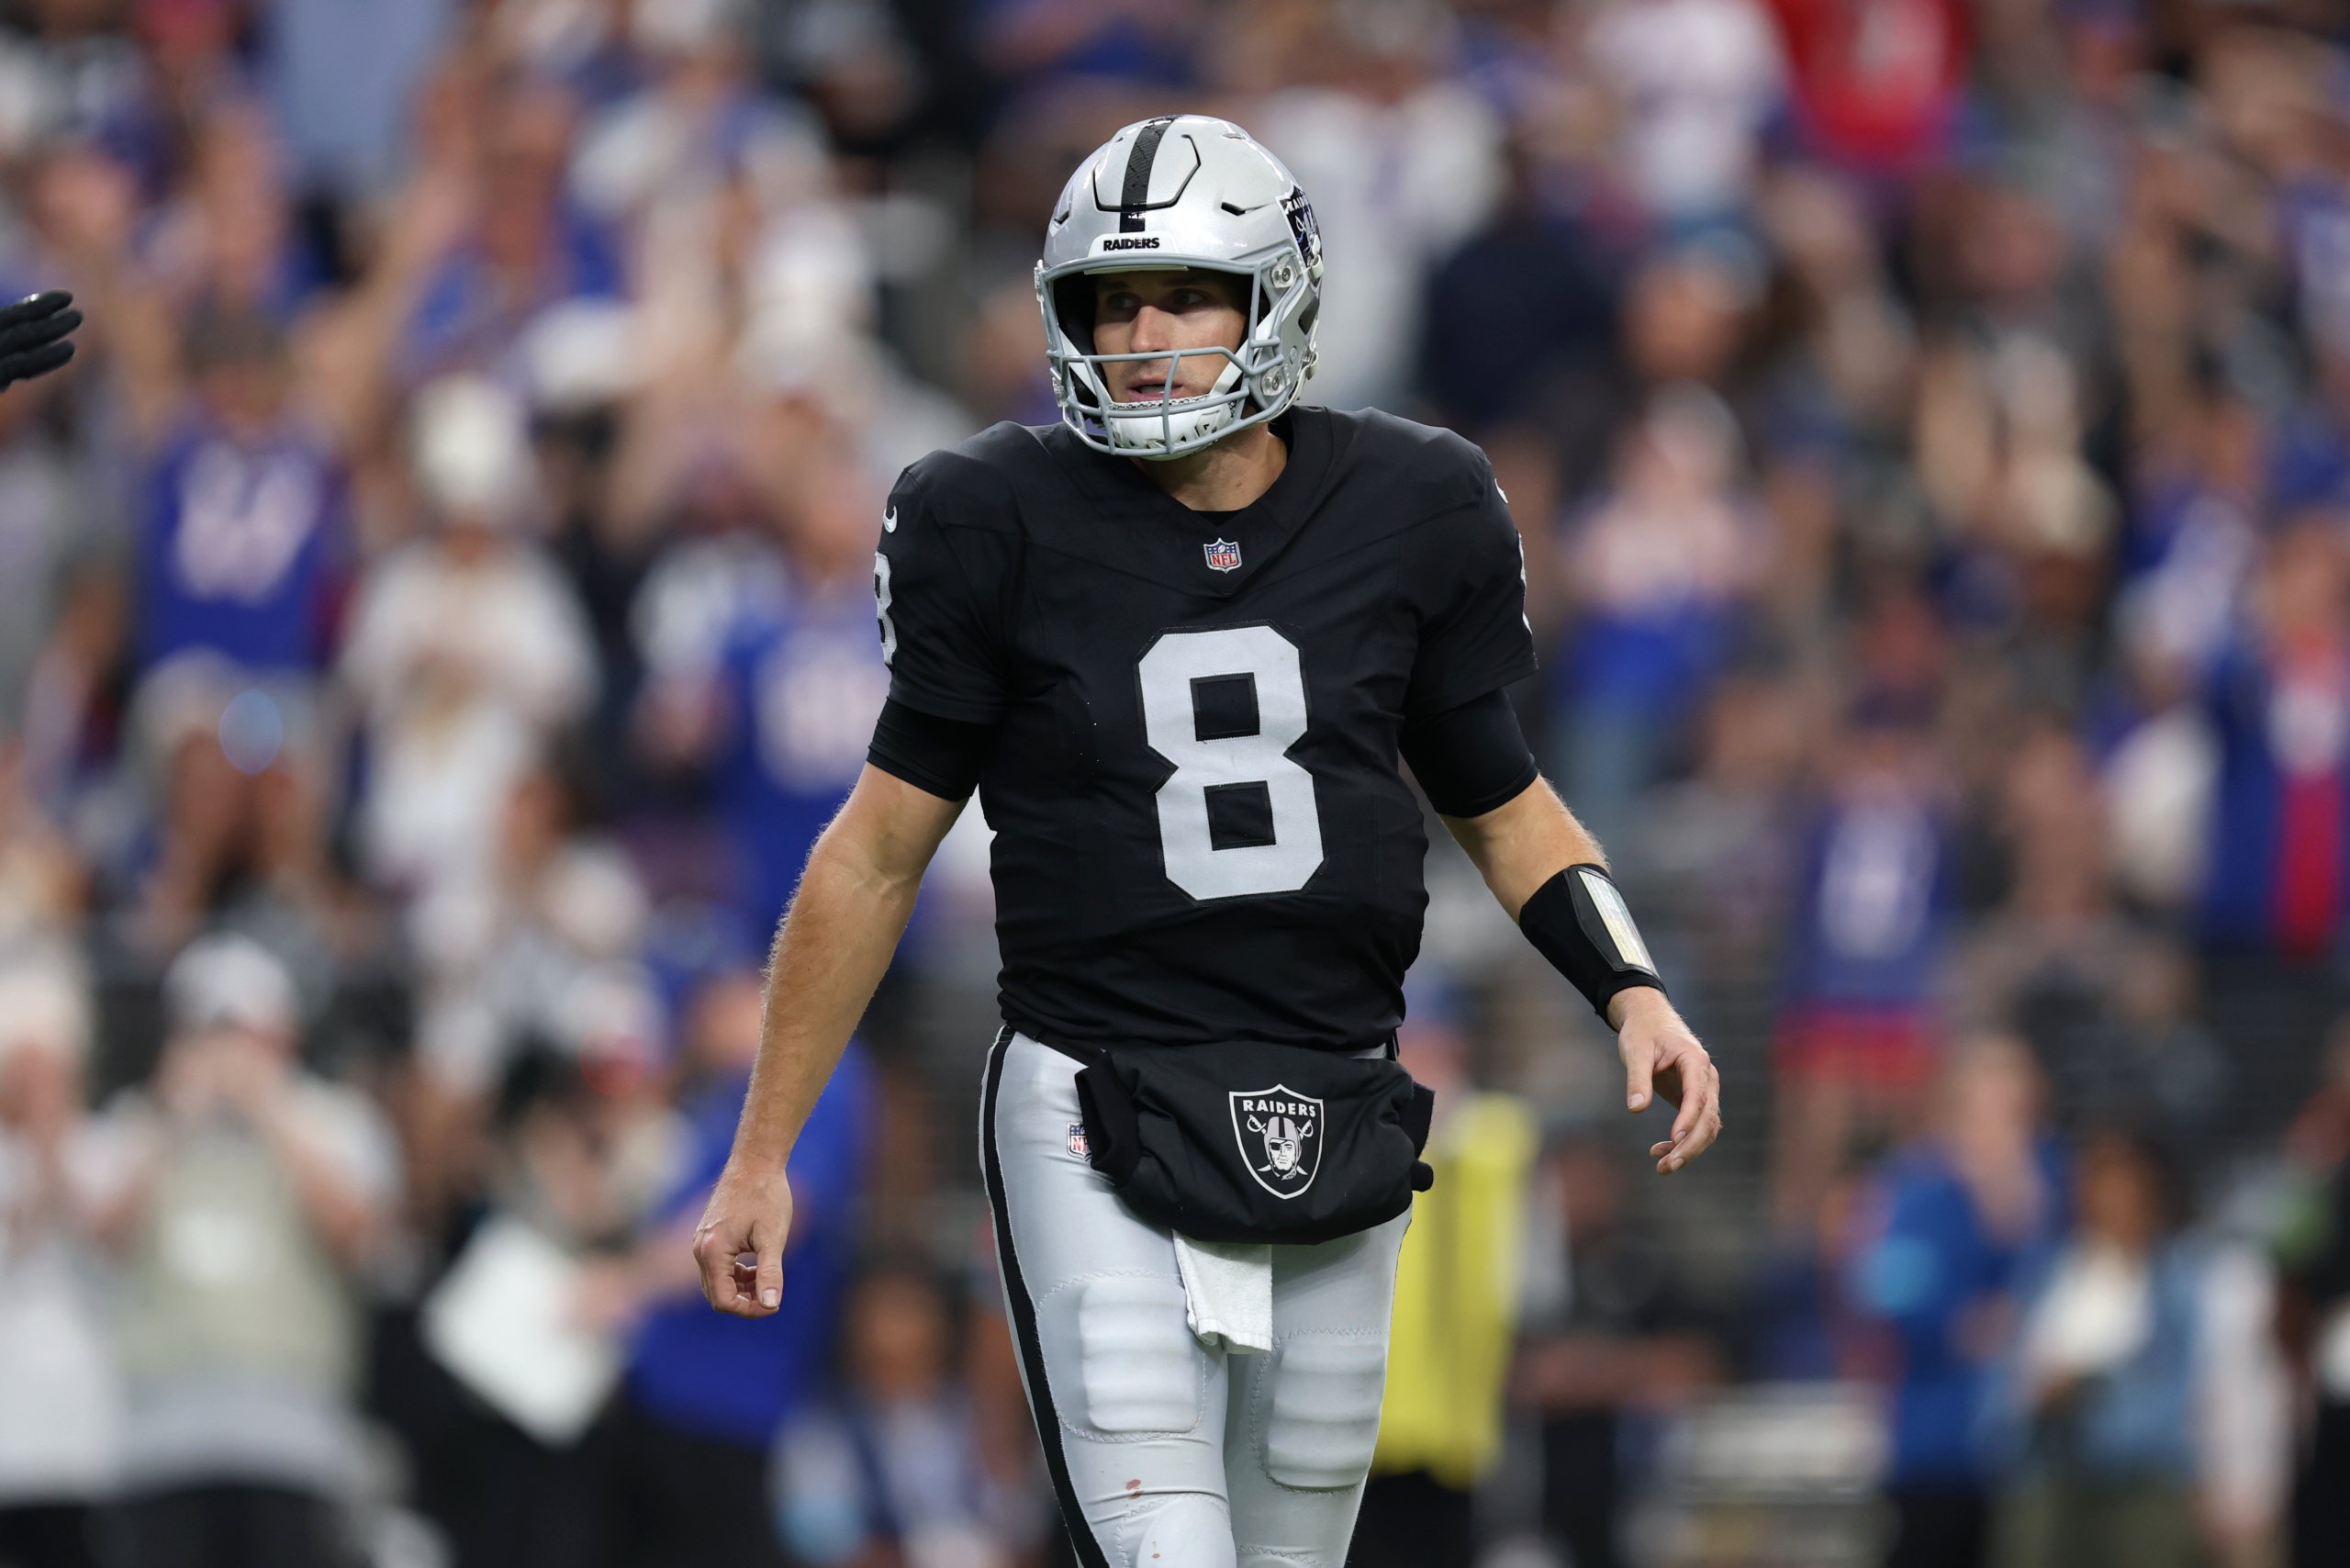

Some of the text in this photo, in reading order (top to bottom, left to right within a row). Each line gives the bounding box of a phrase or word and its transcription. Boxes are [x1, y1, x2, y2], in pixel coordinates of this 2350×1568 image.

[1103, 238, 1159, 251] RAIDERS
[1211, 554, 1237, 566] NFL
[1138, 625, 1324, 901] 8
[1242, 1099, 1316, 1117] RAIDERS
